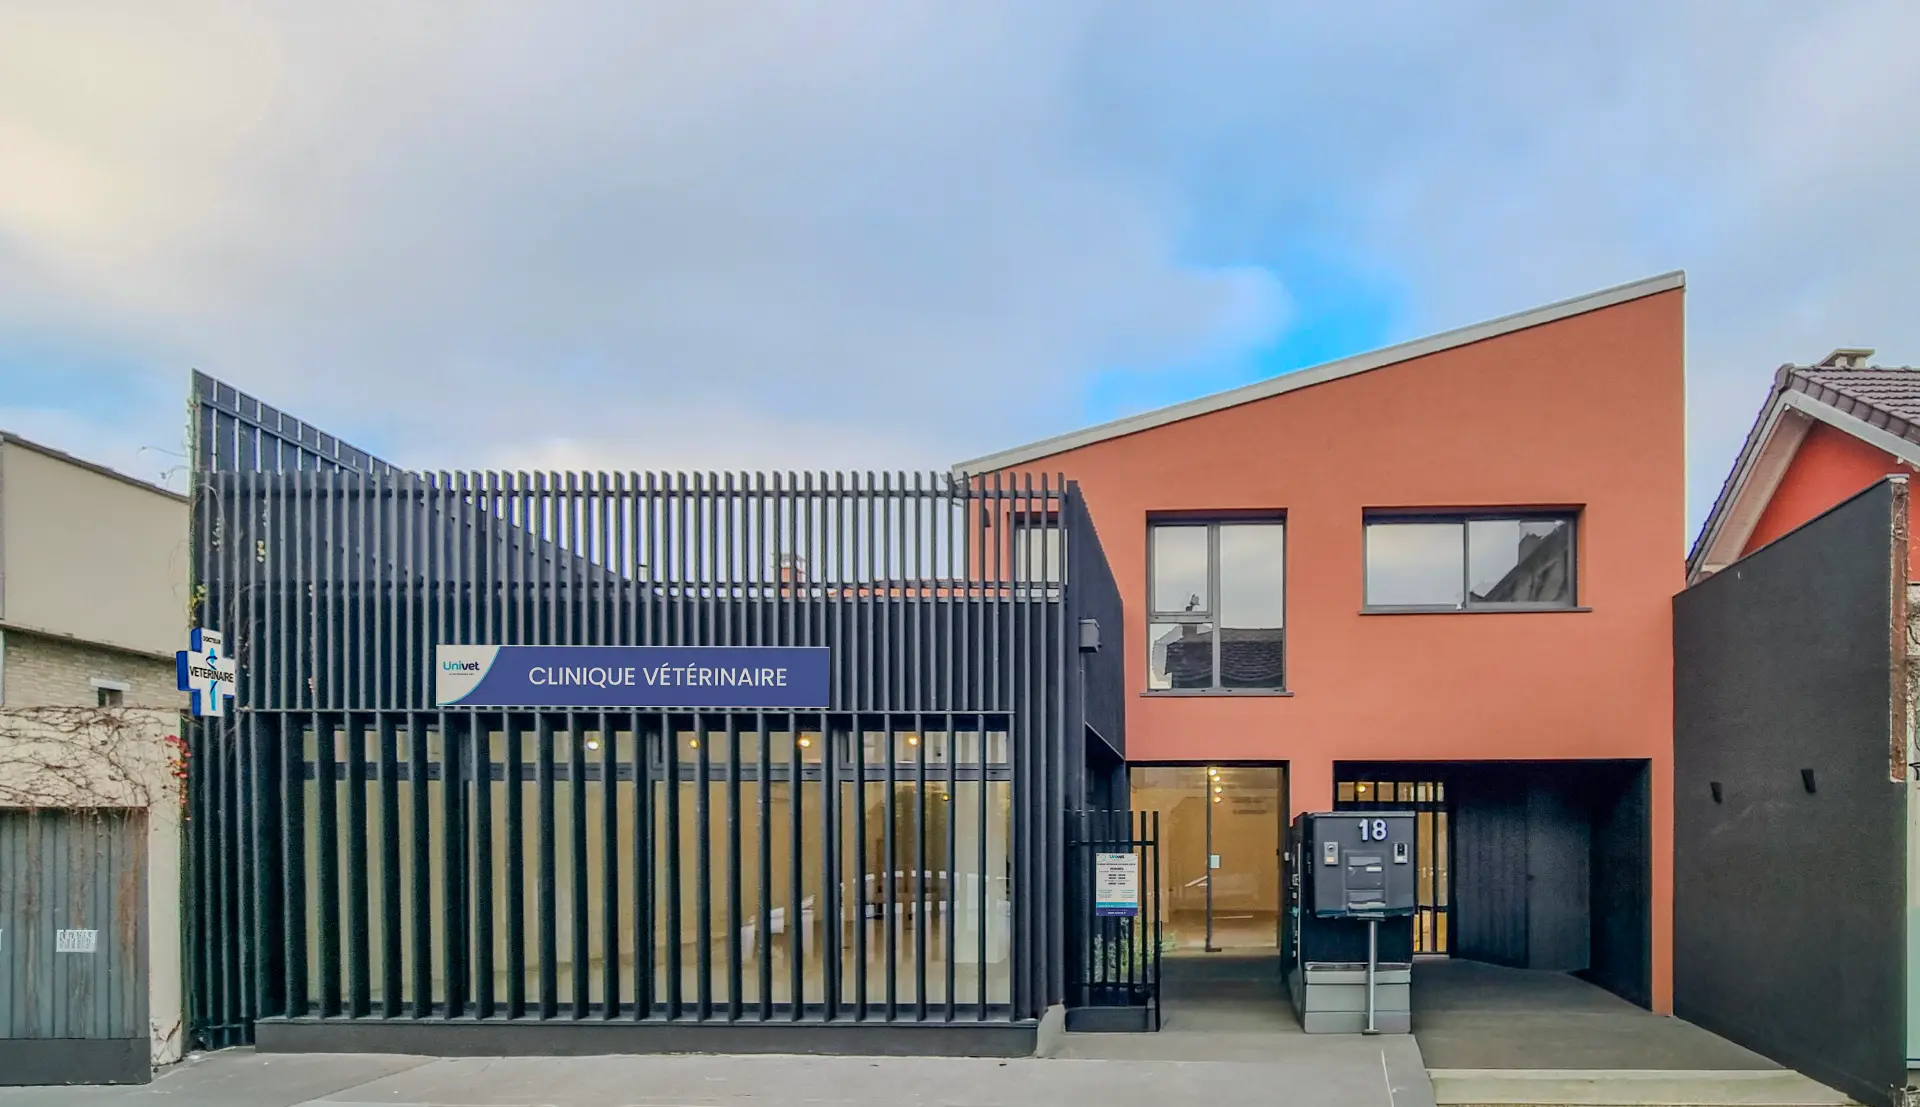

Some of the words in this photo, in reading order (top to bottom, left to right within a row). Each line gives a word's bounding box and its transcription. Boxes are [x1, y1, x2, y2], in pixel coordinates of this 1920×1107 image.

[203, 636, 221, 644] DOCTEUR
[443, 660, 480, 671] Univet
[189, 666, 234, 683] VETERINAIRE
[529, 666, 636, 688] CLINIQUE
[643, 662, 787, 687] VÉTÉRINAIRE
[1358, 818, 1388, 841] 18
